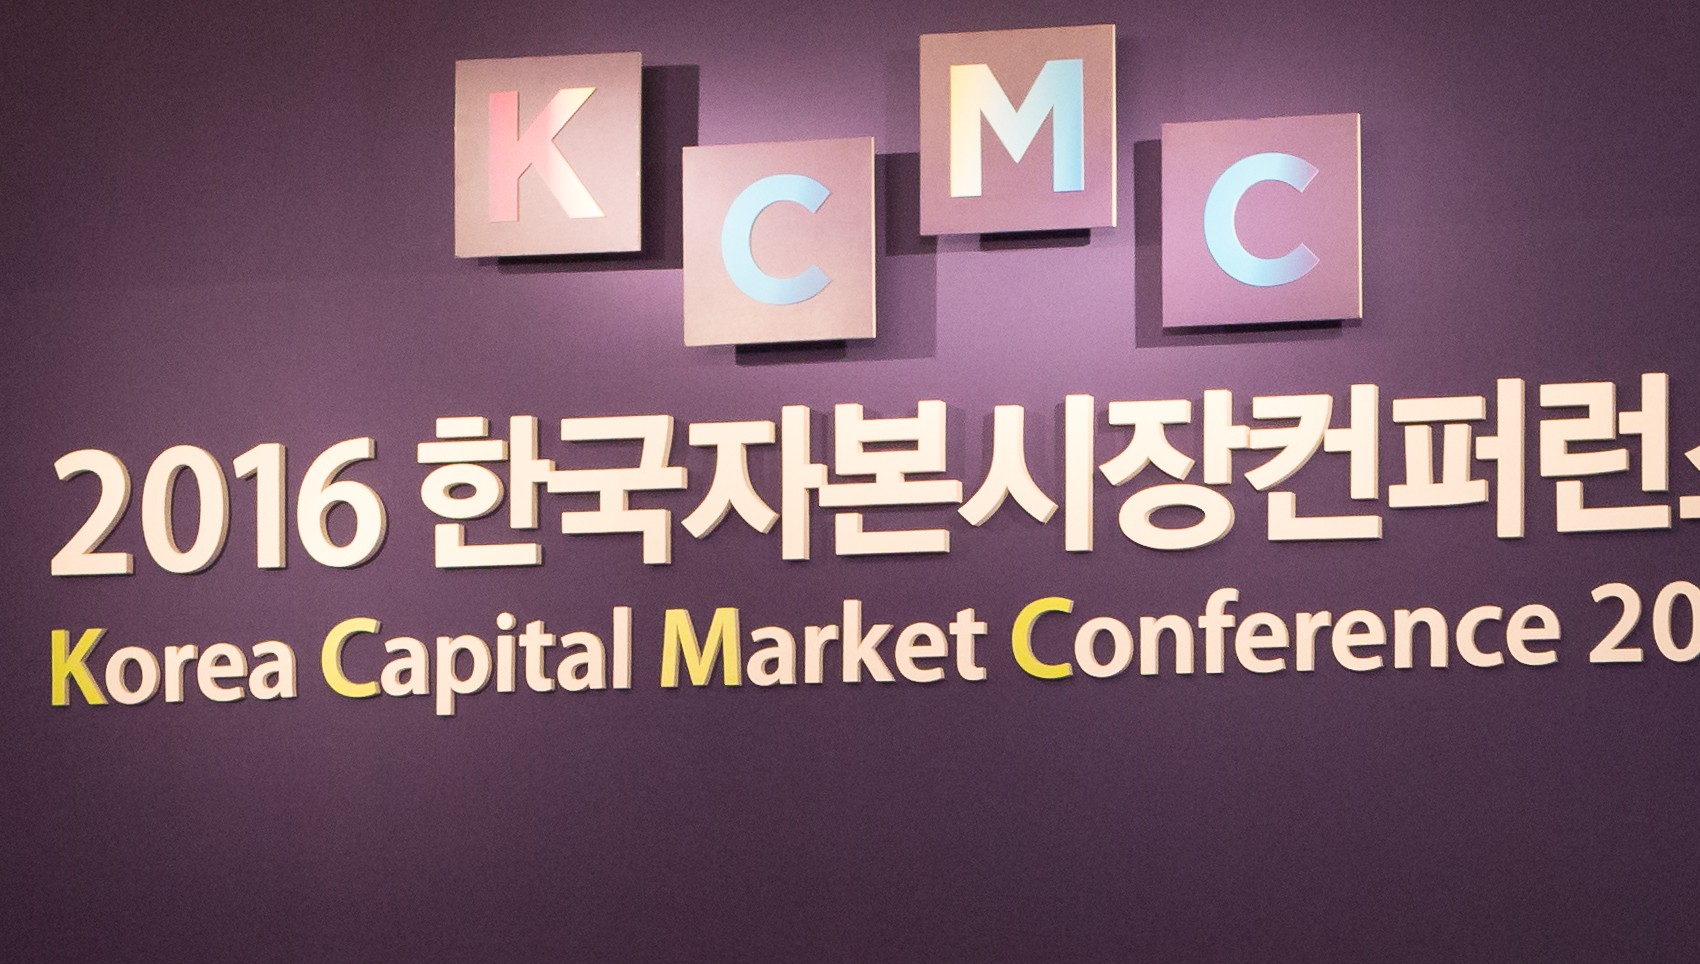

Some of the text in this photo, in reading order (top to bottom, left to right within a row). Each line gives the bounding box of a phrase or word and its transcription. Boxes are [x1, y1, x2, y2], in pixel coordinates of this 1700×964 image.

[50, 437, 387, 577] 2016
[50, 627, 298, 707] Korea
[321, 606, 633, 716] Capital
[660, 600, 988, 688] Market
[1011, 587, 1562, 679] Conference
